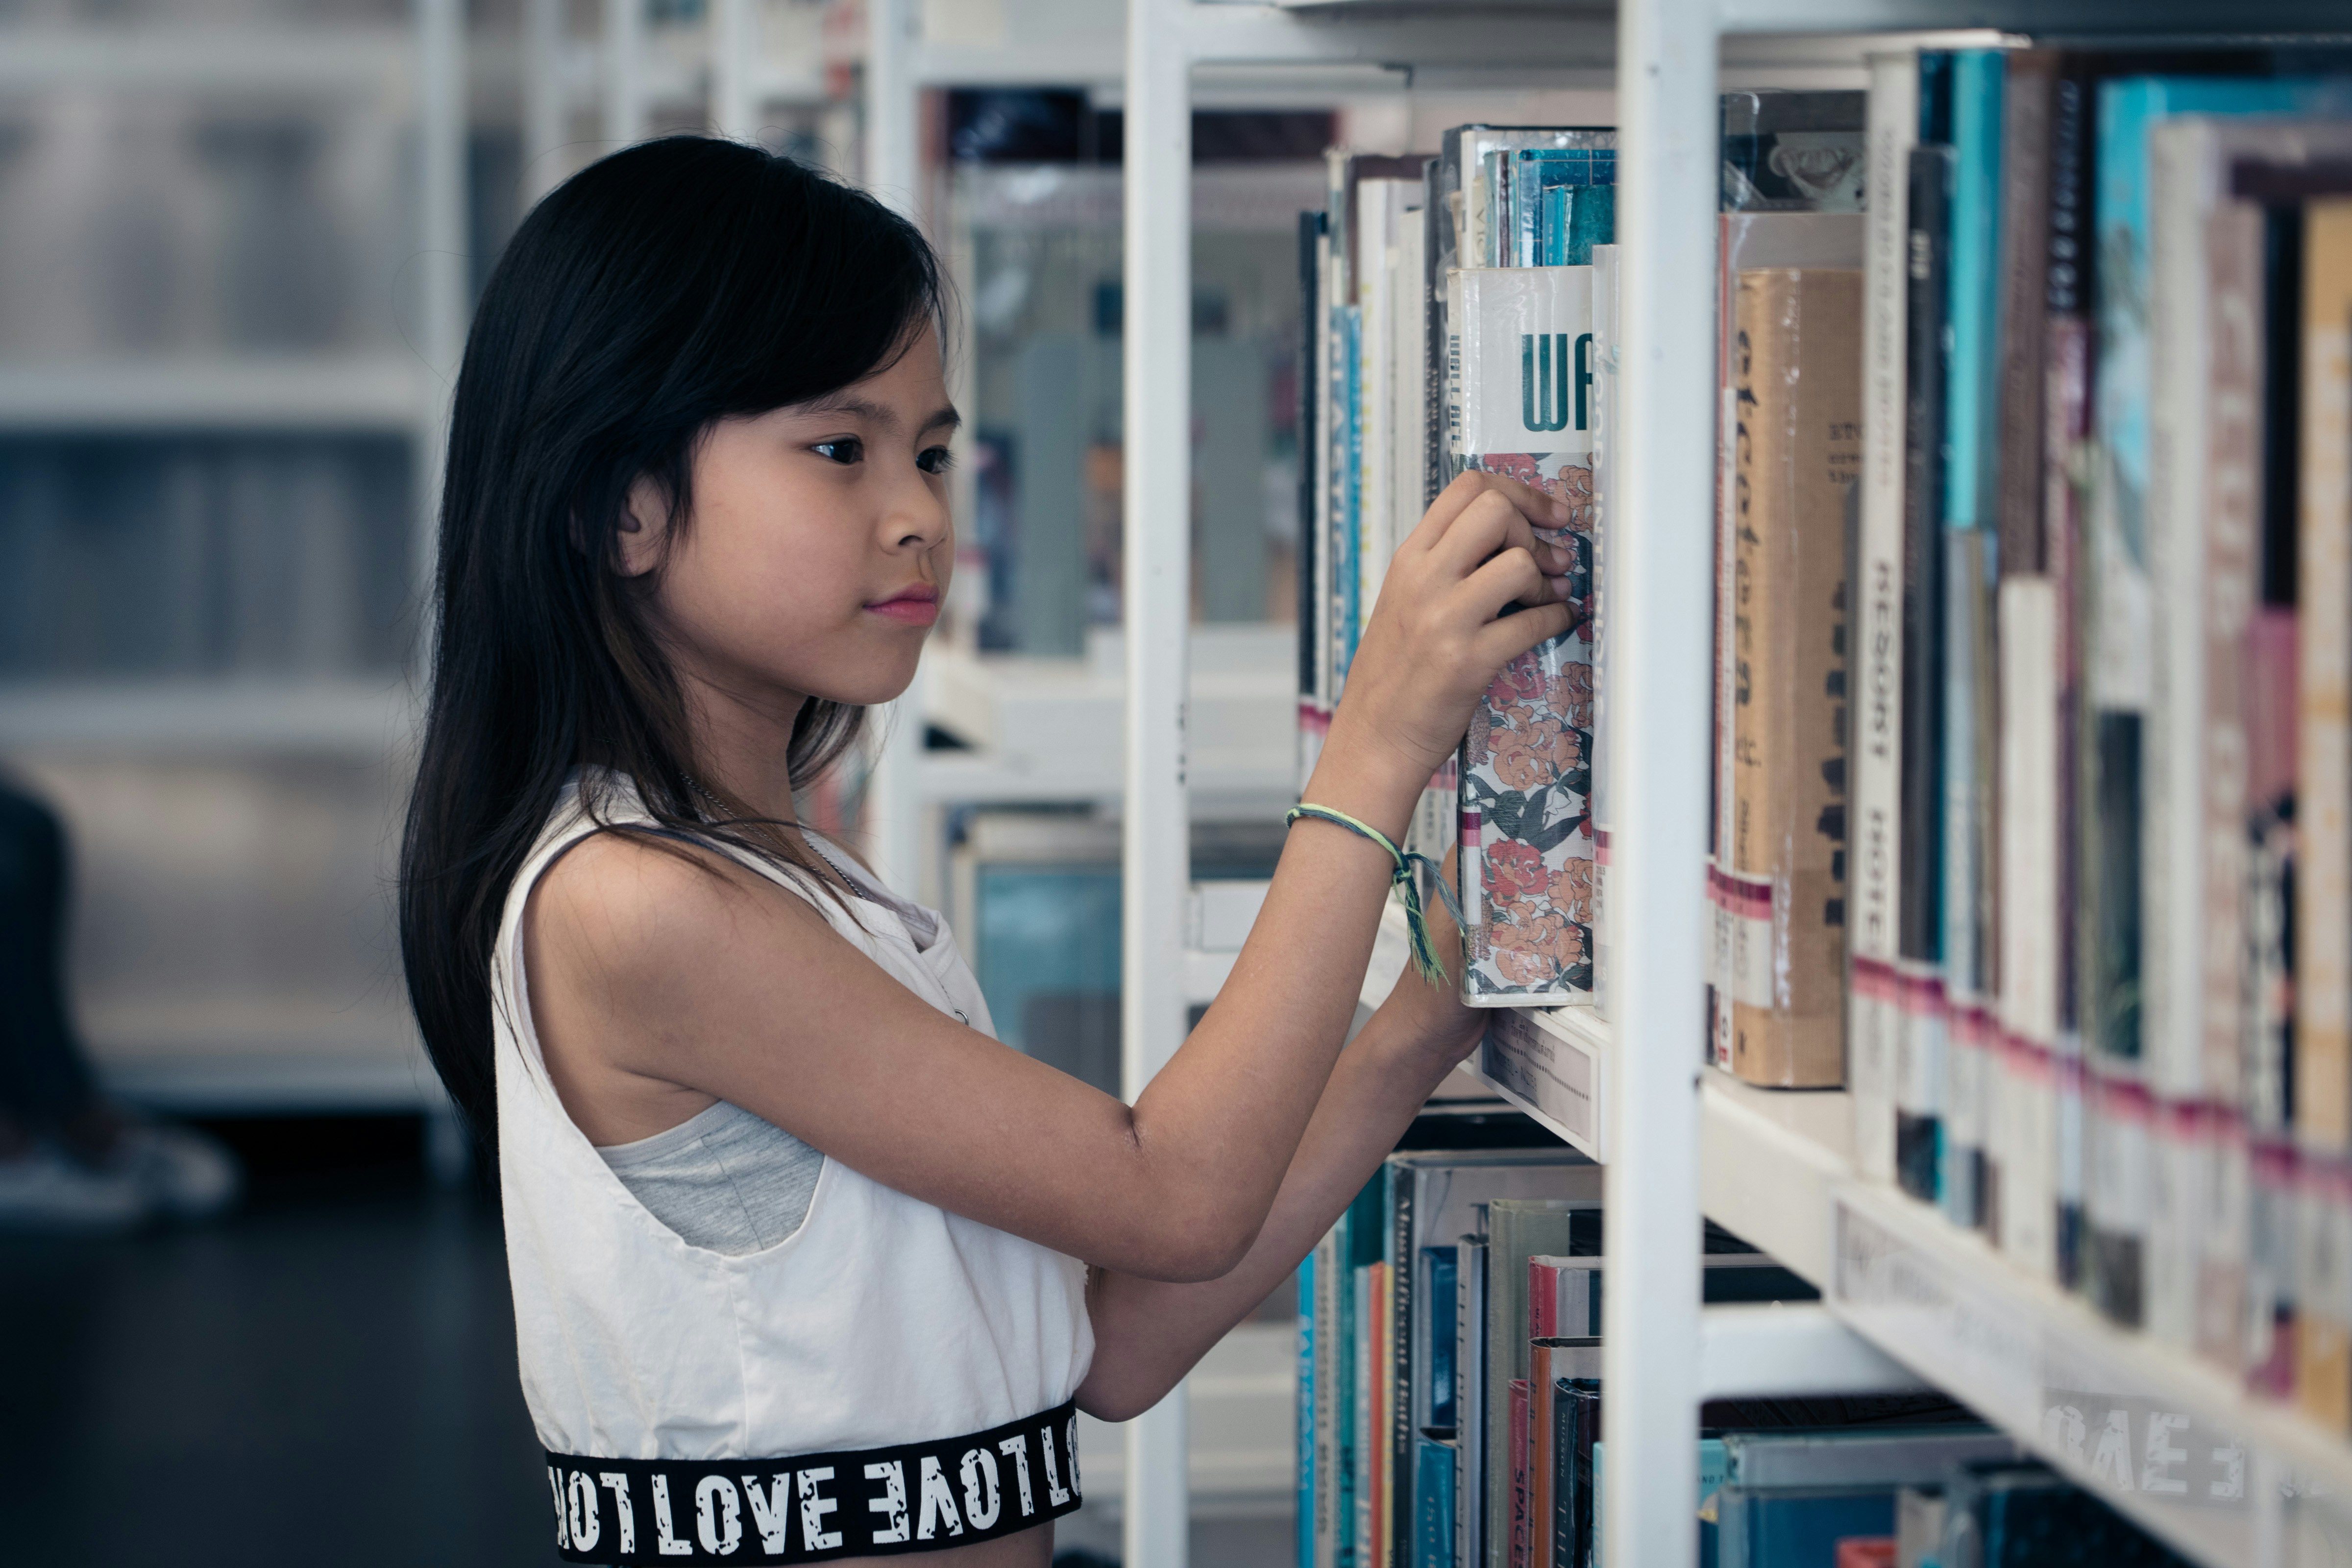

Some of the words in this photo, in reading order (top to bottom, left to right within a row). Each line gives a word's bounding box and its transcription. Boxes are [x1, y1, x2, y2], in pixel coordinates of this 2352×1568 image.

[1593, 330, 1604, 469] WOOD
[652, 1467, 843, 1556] LOVE
[1557, 1500, 1568, 1568] TH
